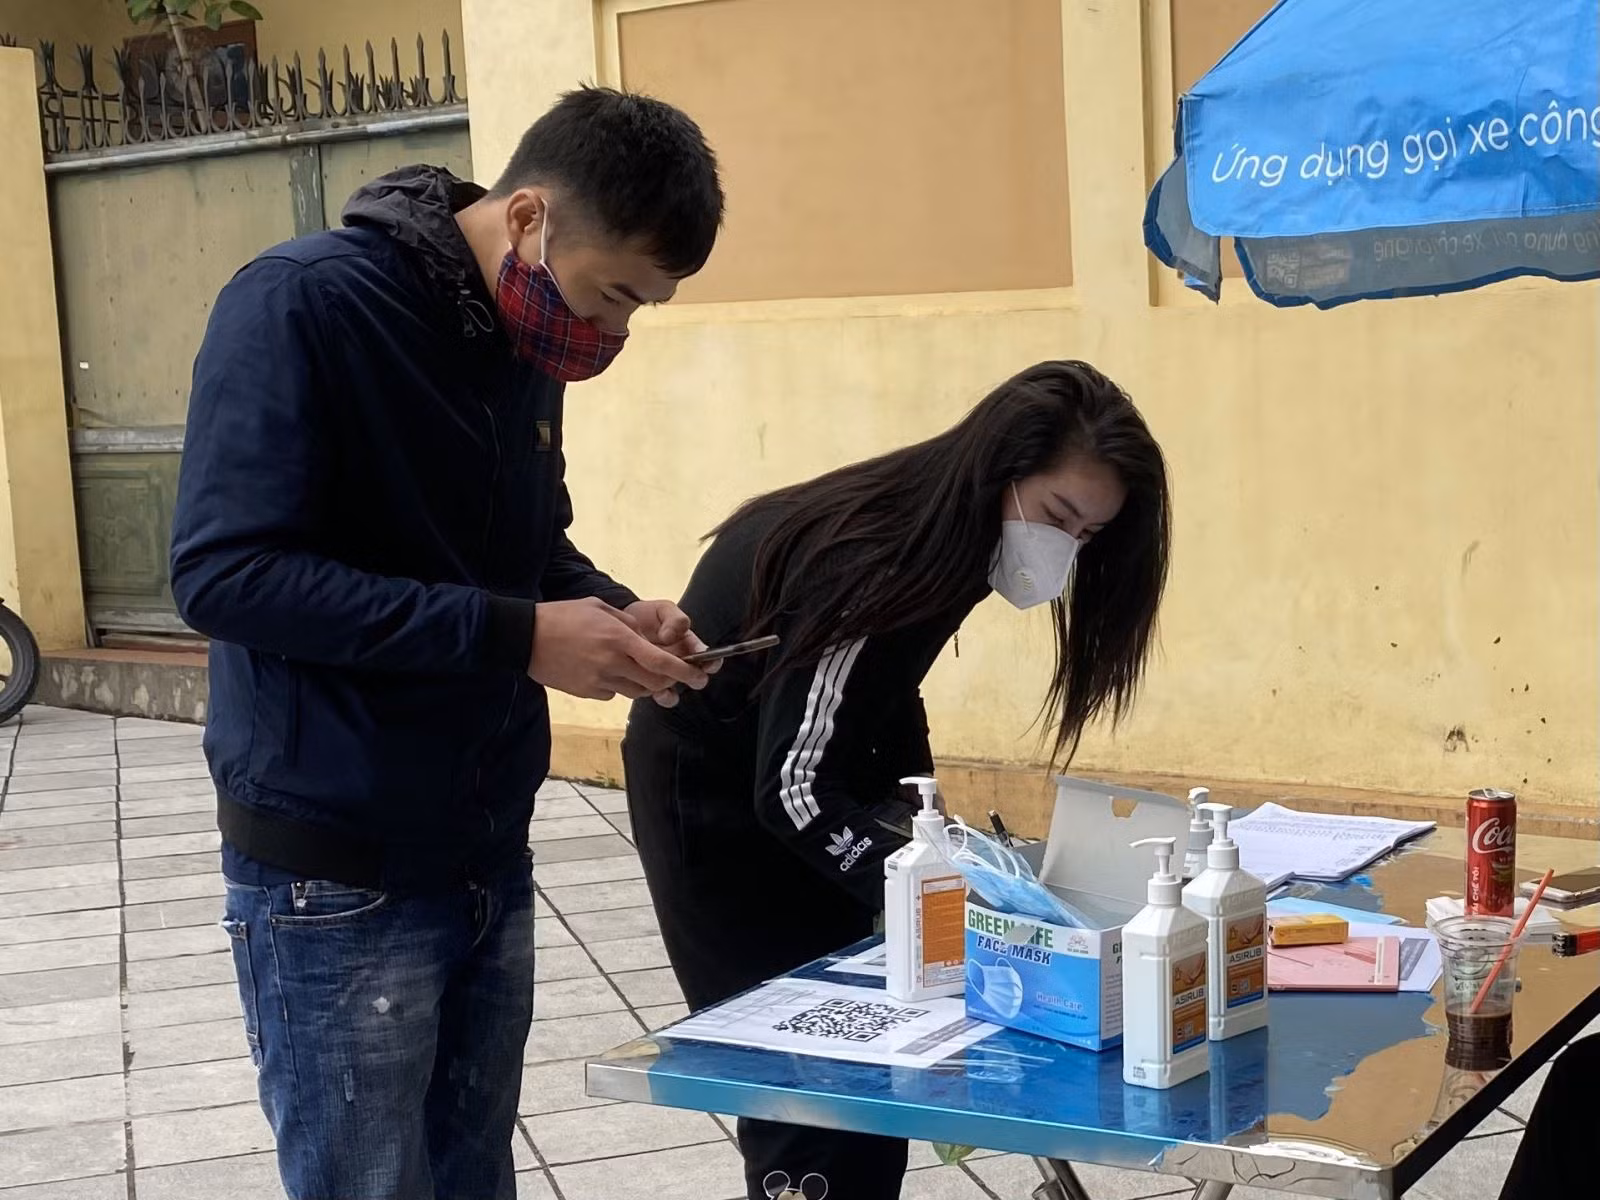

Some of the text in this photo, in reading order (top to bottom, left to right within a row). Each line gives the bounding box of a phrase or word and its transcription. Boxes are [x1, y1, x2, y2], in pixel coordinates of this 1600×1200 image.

[1212, 143, 1288, 187] Ứng
[1300, 139, 1389, 186] dụng
[1402, 117, 1457, 174] gọi
[1467, 117, 1509, 155] xe
[840, 837, 872, 871] adidas
[968, 909, 1015, 938] GREEN
[1011, 944, 1052, 965] MASK
[1229, 947, 1262, 963] ASIRUB
[1174, 987, 1204, 1005] ASIRUB
